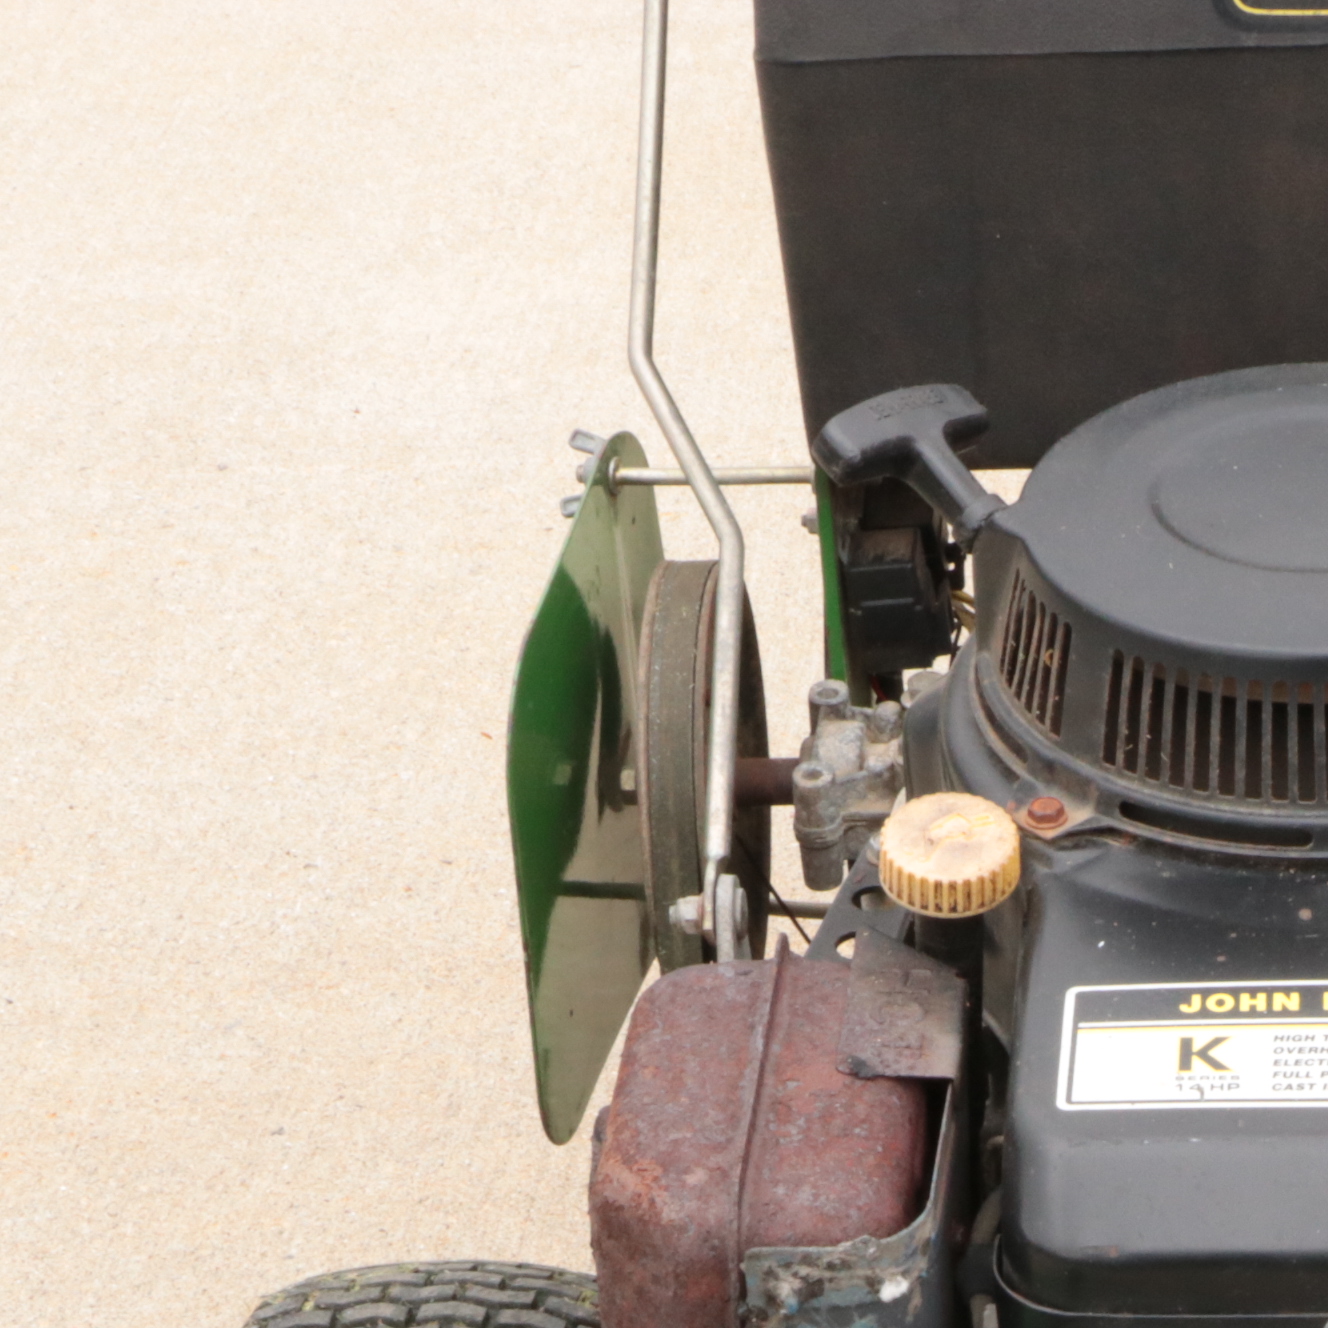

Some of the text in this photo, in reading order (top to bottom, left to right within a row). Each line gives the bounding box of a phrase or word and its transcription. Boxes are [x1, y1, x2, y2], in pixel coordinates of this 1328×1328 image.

[1179, 991, 1300, 1013] JOHN
[1273, 1034, 1316, 1042] HIGH
[1177, 1036, 1233, 1072] K
[1272, 1071, 1313, 1079] FULL
[1175, 1083, 1240, 1092] 14 HP
[1272, 1083, 1317, 1091] CAST
